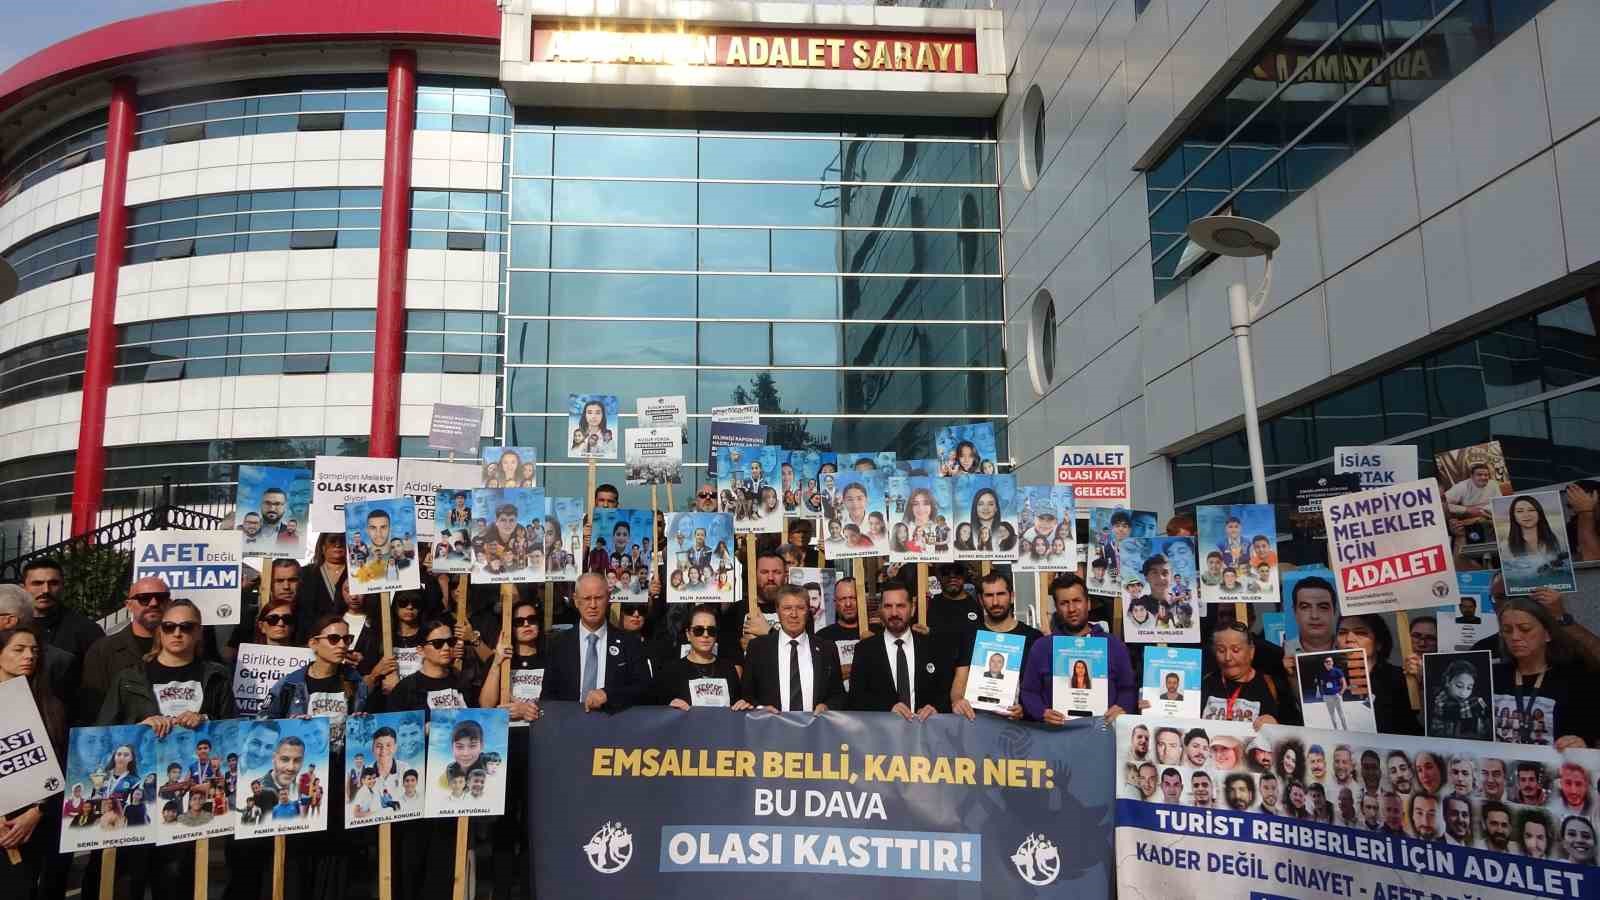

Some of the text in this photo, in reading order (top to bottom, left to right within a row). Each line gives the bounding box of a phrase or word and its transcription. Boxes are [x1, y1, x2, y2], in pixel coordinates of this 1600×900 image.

[726, 36, 845, 68] ADALET
[852, 40, 965, 72] SARAYI
[1061, 453, 1124, 465] ADALET
[1340, 453, 1381, 467] İSİAS
[317, 482, 394, 494] OLASI KAST
[1059, 470, 1125, 481] OLASI KAST
[1074, 486, 1125, 497] GELECEK
[1330, 487, 1433, 524] ŞAMPİYON
[1334, 510, 1436, 542] MELEKLER
[141, 543, 209, 562] AFET
[206, 552, 236, 562] DEĞİL
[1336, 541, 1377, 564] İÇİN
[1347, 549, 1439, 591] ADALET
[242, 654, 285, 667] Birlikte
[592, 743, 1055, 790] EMSALLER BELLİ, KARAR NET:
[755, 788, 887, 820] BU DAVA
[668, 832, 972, 873] OLASI KASTTIR!
[1155, 809, 1584, 898] TURİST REHBERLERİ İÇİN ADALET
[1136, 841, 1201, 870] KADER
[1207, 851, 1269, 880] DEĞİL
[1274, 859, 1354, 897] CİNAYET
